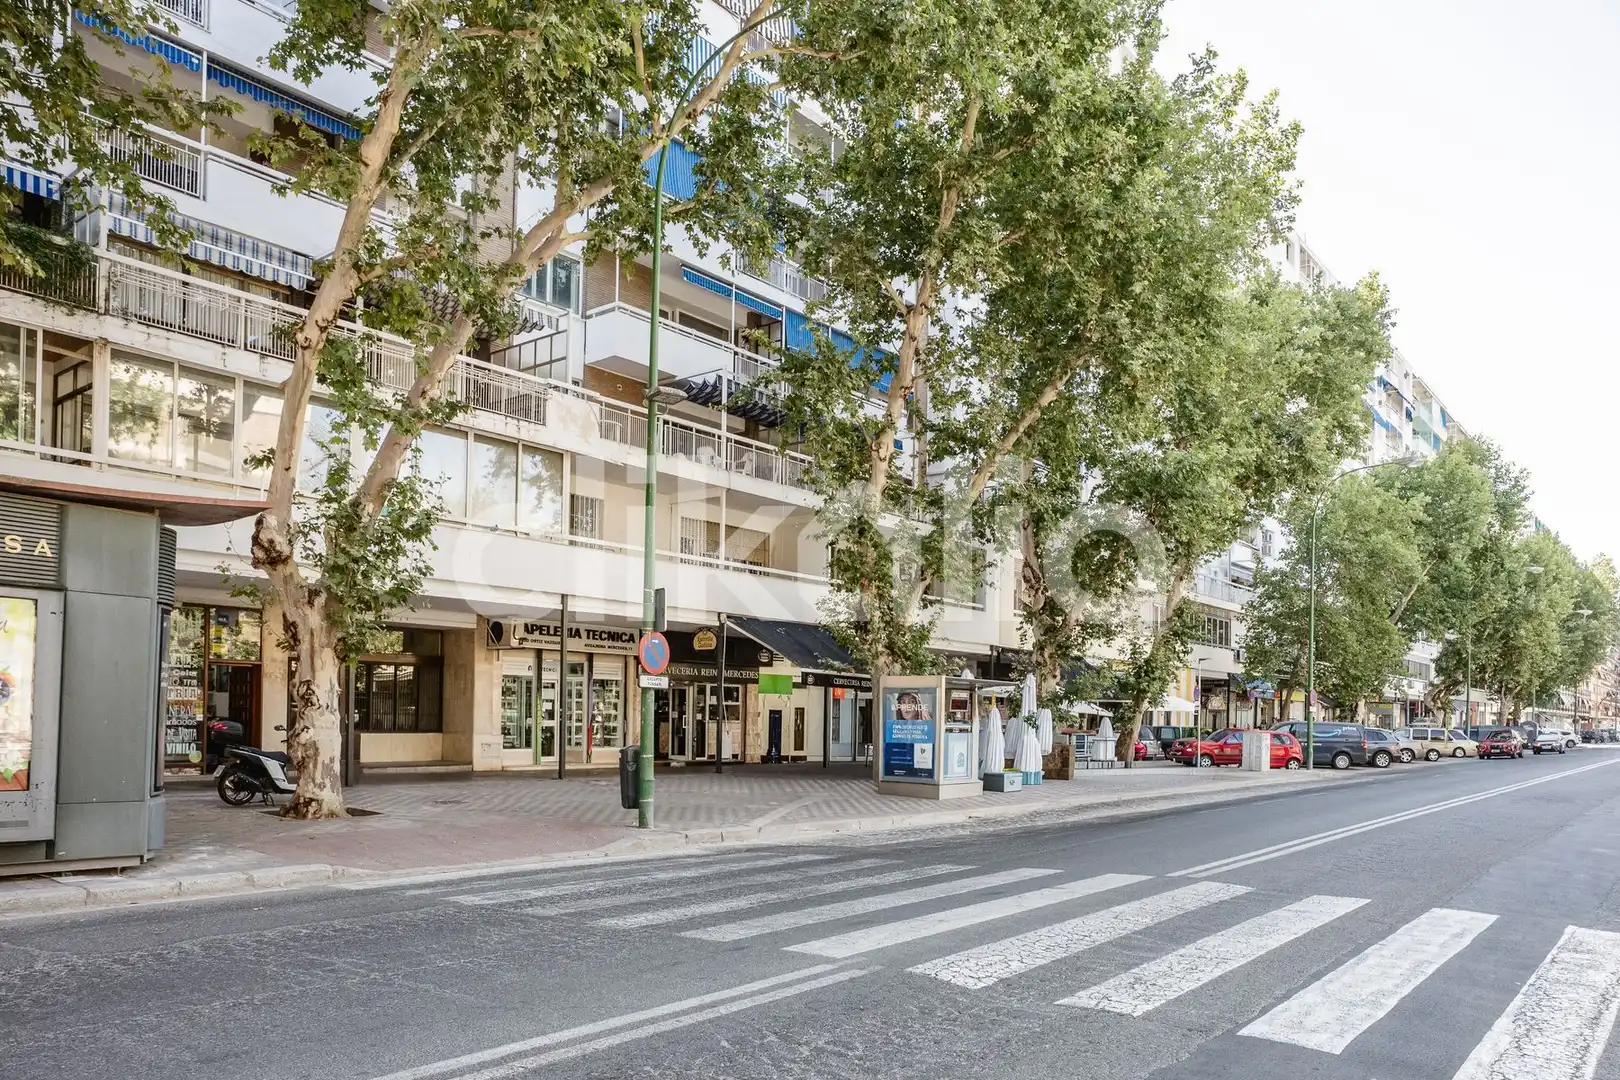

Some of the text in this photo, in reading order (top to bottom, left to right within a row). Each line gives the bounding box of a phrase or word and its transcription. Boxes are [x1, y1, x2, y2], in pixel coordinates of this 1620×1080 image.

[522, 622, 636, 644] APELEIA TECNICA
[663, 666, 759, 679] RVECERIA REIN MERCEDES
[861, 679, 872, 687] REIN
[166, 742, 197, 755] VINILO
